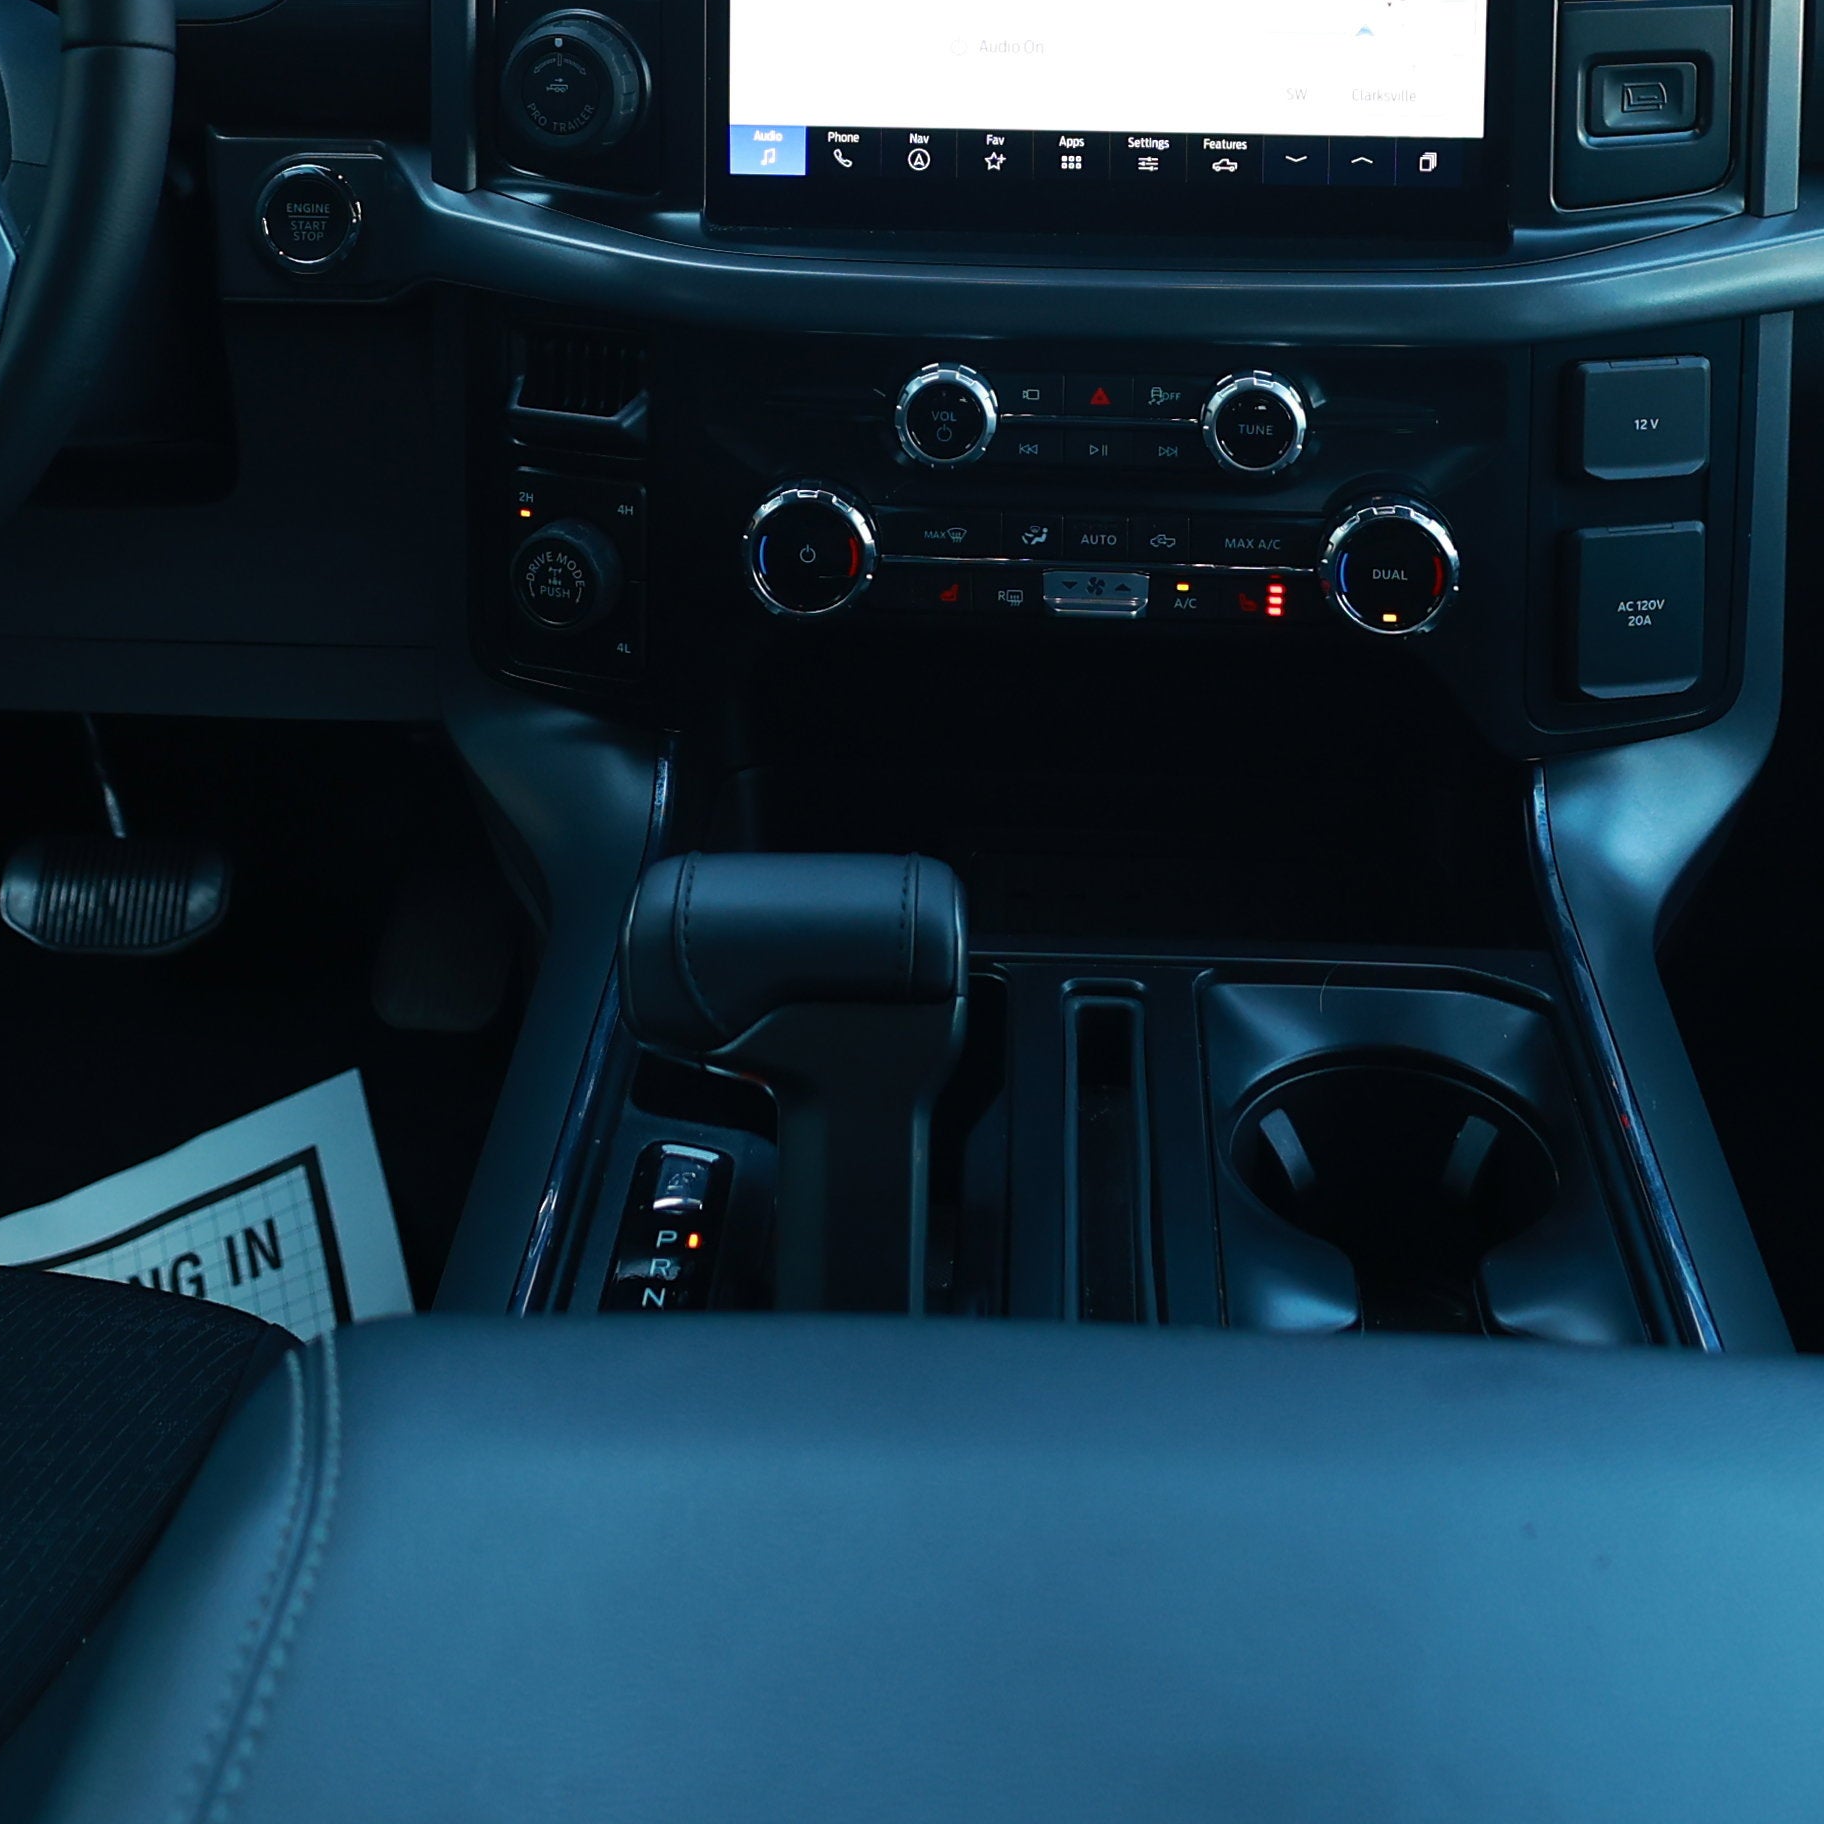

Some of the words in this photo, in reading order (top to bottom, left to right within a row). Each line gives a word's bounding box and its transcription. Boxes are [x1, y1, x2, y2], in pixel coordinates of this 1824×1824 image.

[979, 39, 1021, 54] Audio
[1023, 39, 1045, 54] On
[1286, 87, 1308, 101] SW
[1351, 88, 1417, 102] Clarksville
[527, 101, 549, 127] PRO
[551, 104, 596, 135] TRAILER
[753, 129, 783, 142] Audio
[826, 131, 861, 144] Phone
[908, 132, 930, 145] Nav
[985, 134, 1006, 146] Fav
[1058, 135, 1085, 150] Apps
[1126, 136, 1171, 151] Settings
[1202, 138, 1249, 151] Features
[285, 202, 331, 214] ENGINE
[290, 220, 328, 231] START
[293, 231, 325, 242] STOP
[1162, 391, 1182, 402] OFF
[931, 410, 957, 423] VOL
[1237, 423, 1274, 436] TUNE
[1633, 418, 1648, 431] 12
[1648, 418, 1660, 431] V
[518, 491, 535, 504] 2H
[616, 504, 634, 516] 4H
[923, 529, 946, 540] MAX
[1080, 534, 1117, 546] AUTO
[1224, 537, 1256, 551] MAX
[1257, 537, 1282, 552] A/C
[525, 550, 554, 582] DRIVE
[555, 551, 586, 588] MODE
[1371, 568, 1409, 582] DUAL
[539, 584, 572, 600] PUSH
[1173, 597, 1198, 610] A/C
[1617, 600, 1635, 613] AC
[1636, 598, 1666, 613] 120V
[1627, 614, 1653, 627] 20A
[616, 642, 632, 654] 4L
[656, 1229, 678, 1249] P
[225, 1218, 283, 1287] IN
[649, 1257, 671, 1278] R
[641, 1286, 666, 1309] N
